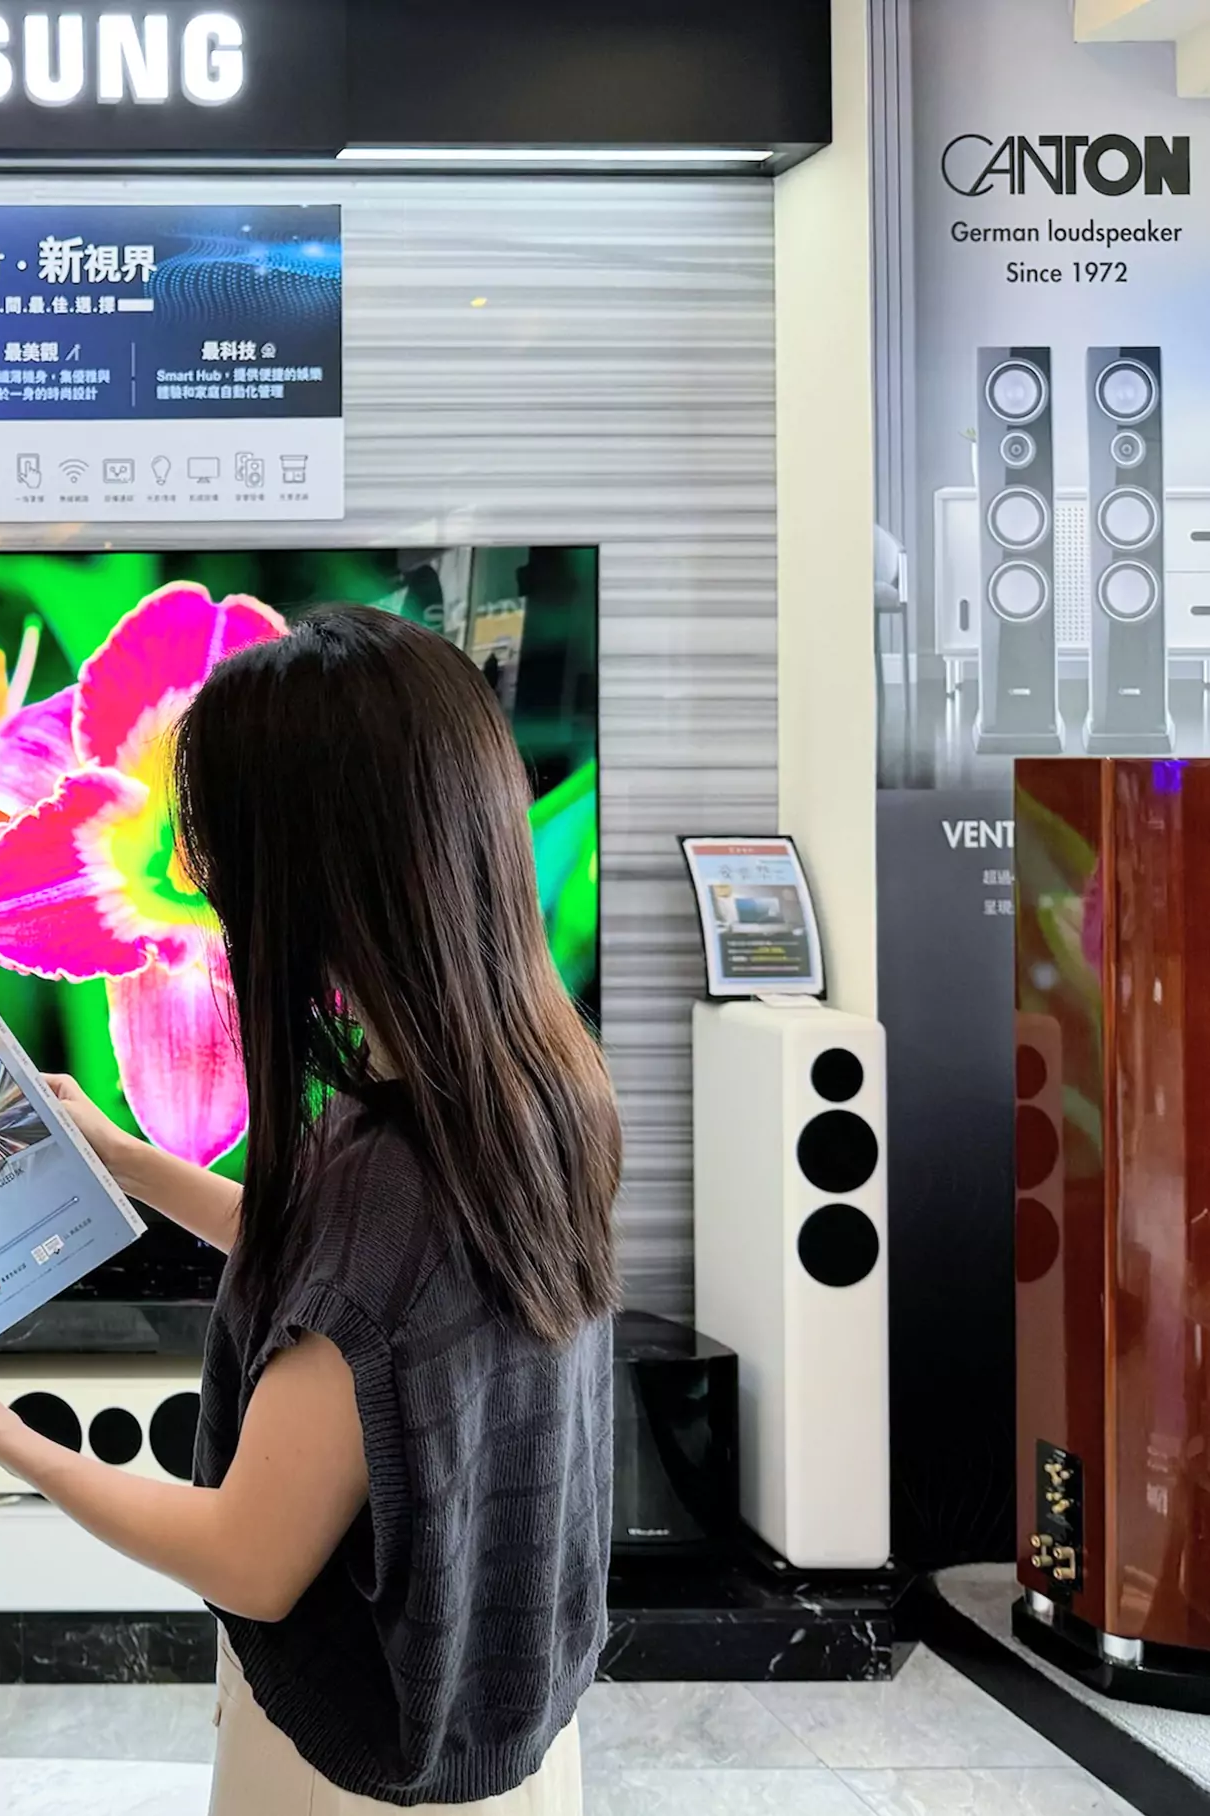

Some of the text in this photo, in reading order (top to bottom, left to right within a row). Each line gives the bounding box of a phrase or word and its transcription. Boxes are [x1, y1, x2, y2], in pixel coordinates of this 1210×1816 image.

[941, 133, 1191, 197] CANTON
[950, 218, 1183, 248] German loudspeaker
[1006, 261, 1129, 284] Since 1972
[3, 341, 60, 363] 最美觀
[200, 340, 257, 362] 最科技
[156, 369, 193, 383] Smart
